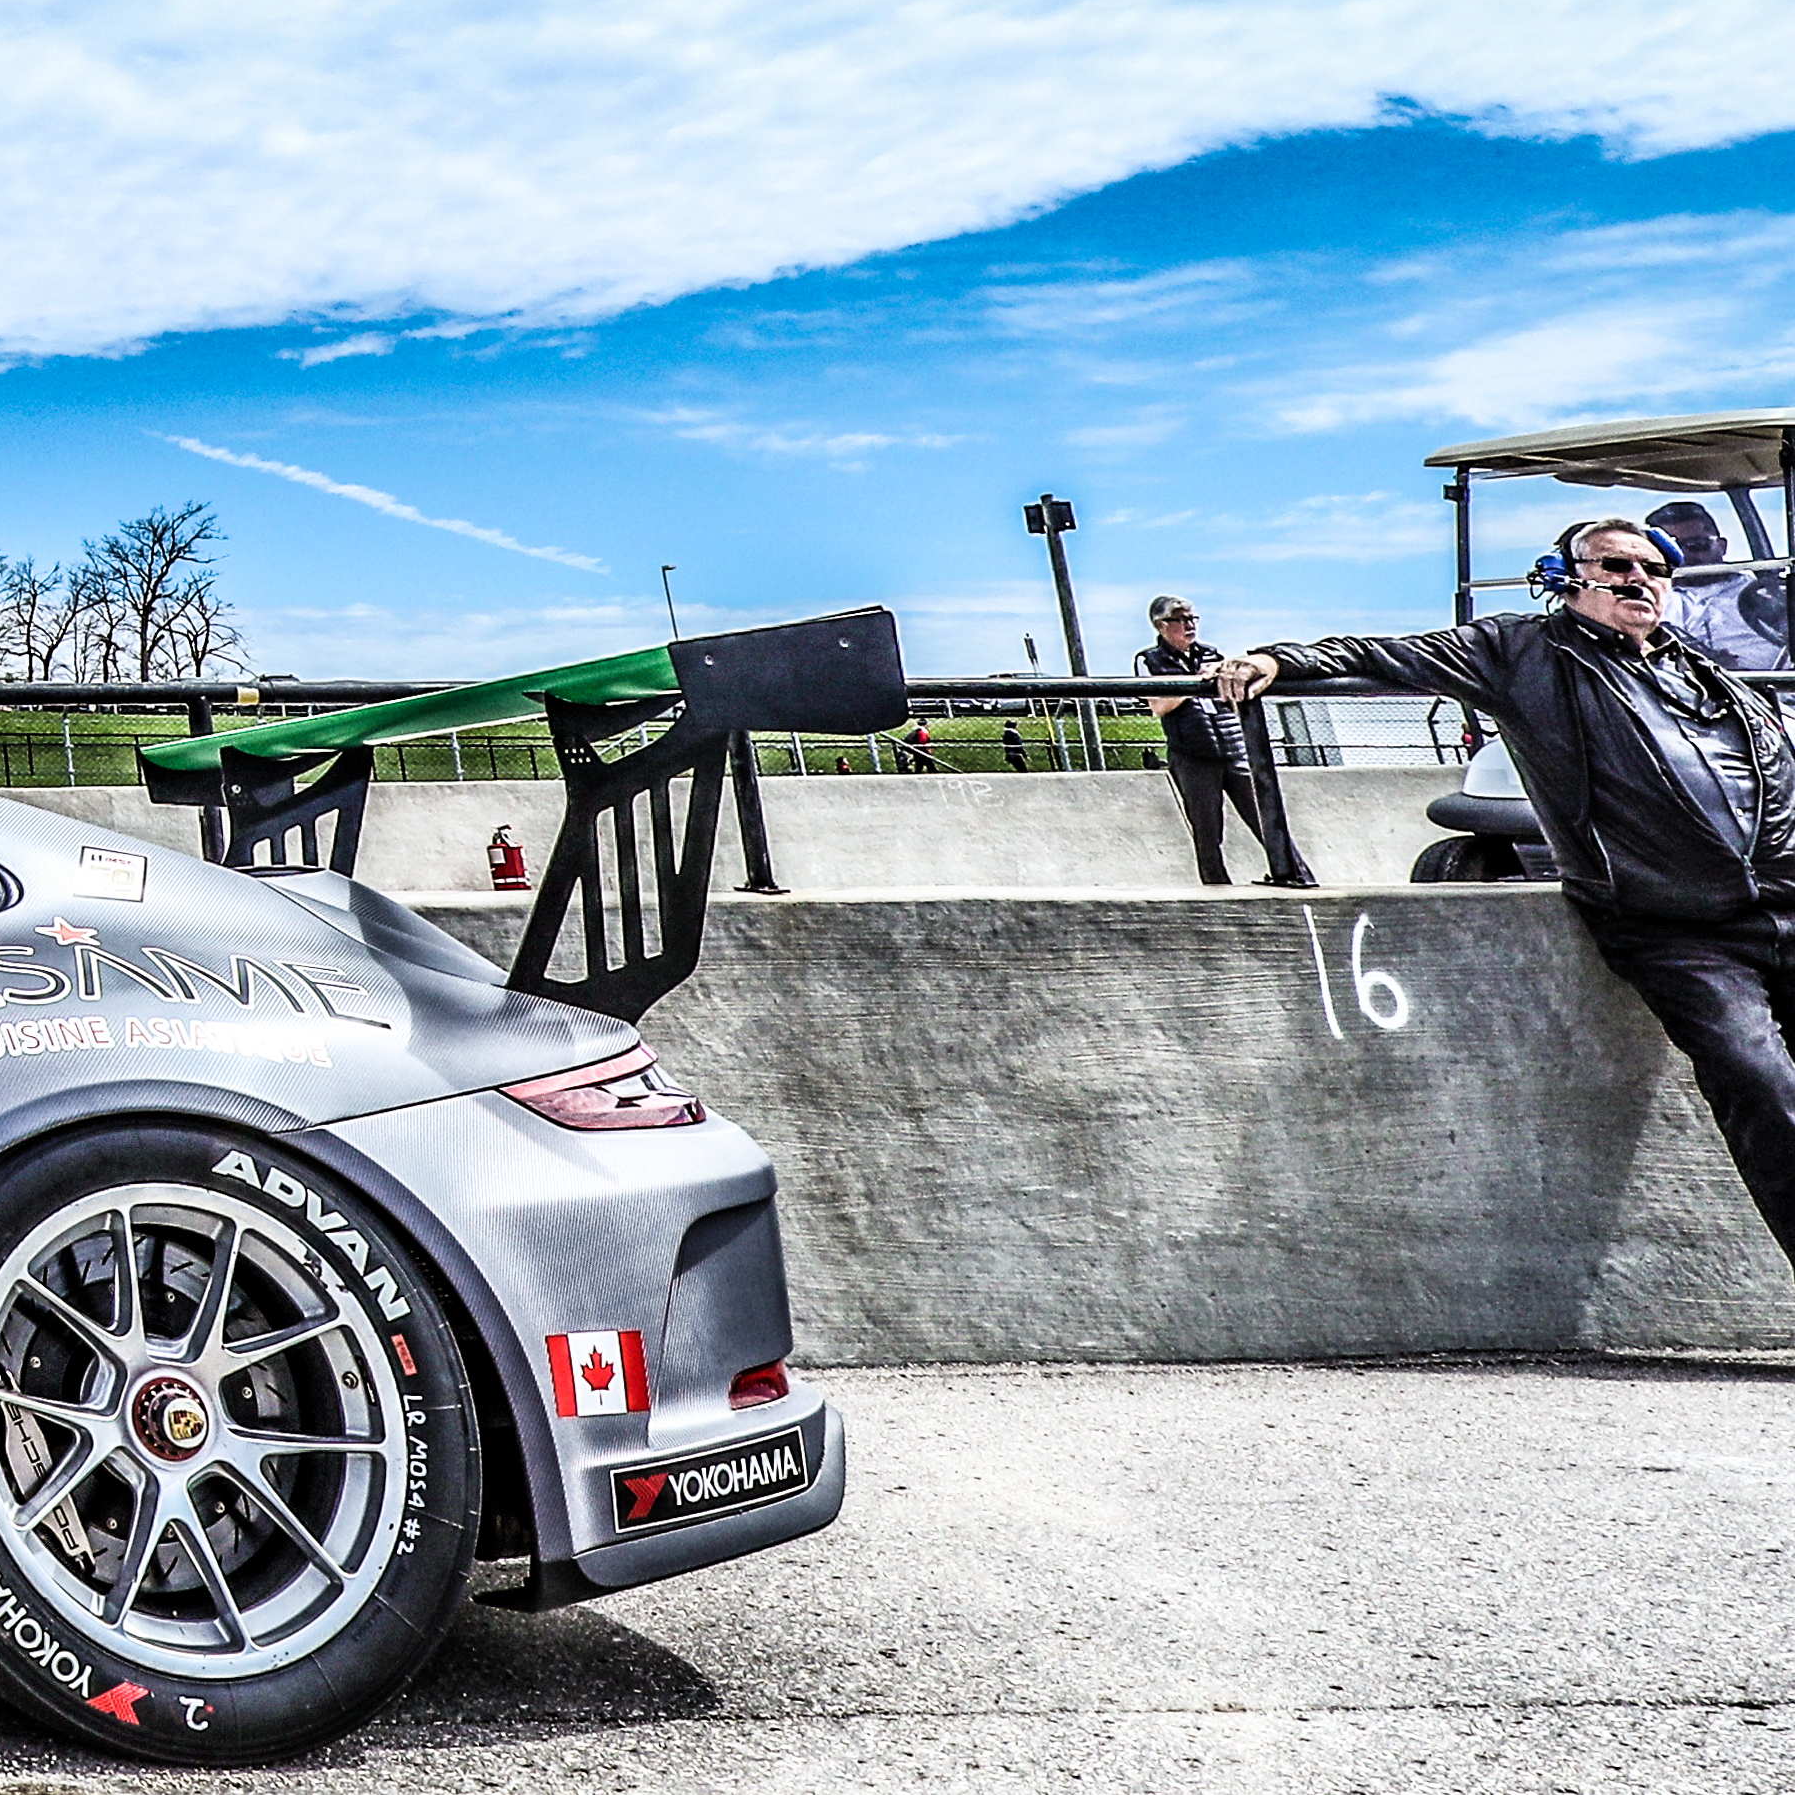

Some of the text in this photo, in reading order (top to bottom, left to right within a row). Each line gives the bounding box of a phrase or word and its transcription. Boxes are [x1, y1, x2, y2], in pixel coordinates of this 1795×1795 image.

[1303, 904, 1409, 1040] 16
[124, 1015, 334, 1069] ASIAUE
[211, 1149, 412, 1322] ADVAN
[402, 1394, 427, 1427] LR
[7, 1402, 79, 1550] POSCHE
[668, 1445, 801, 1506] YOKOHAMA
[178, 1694, 209, 1731] 2
